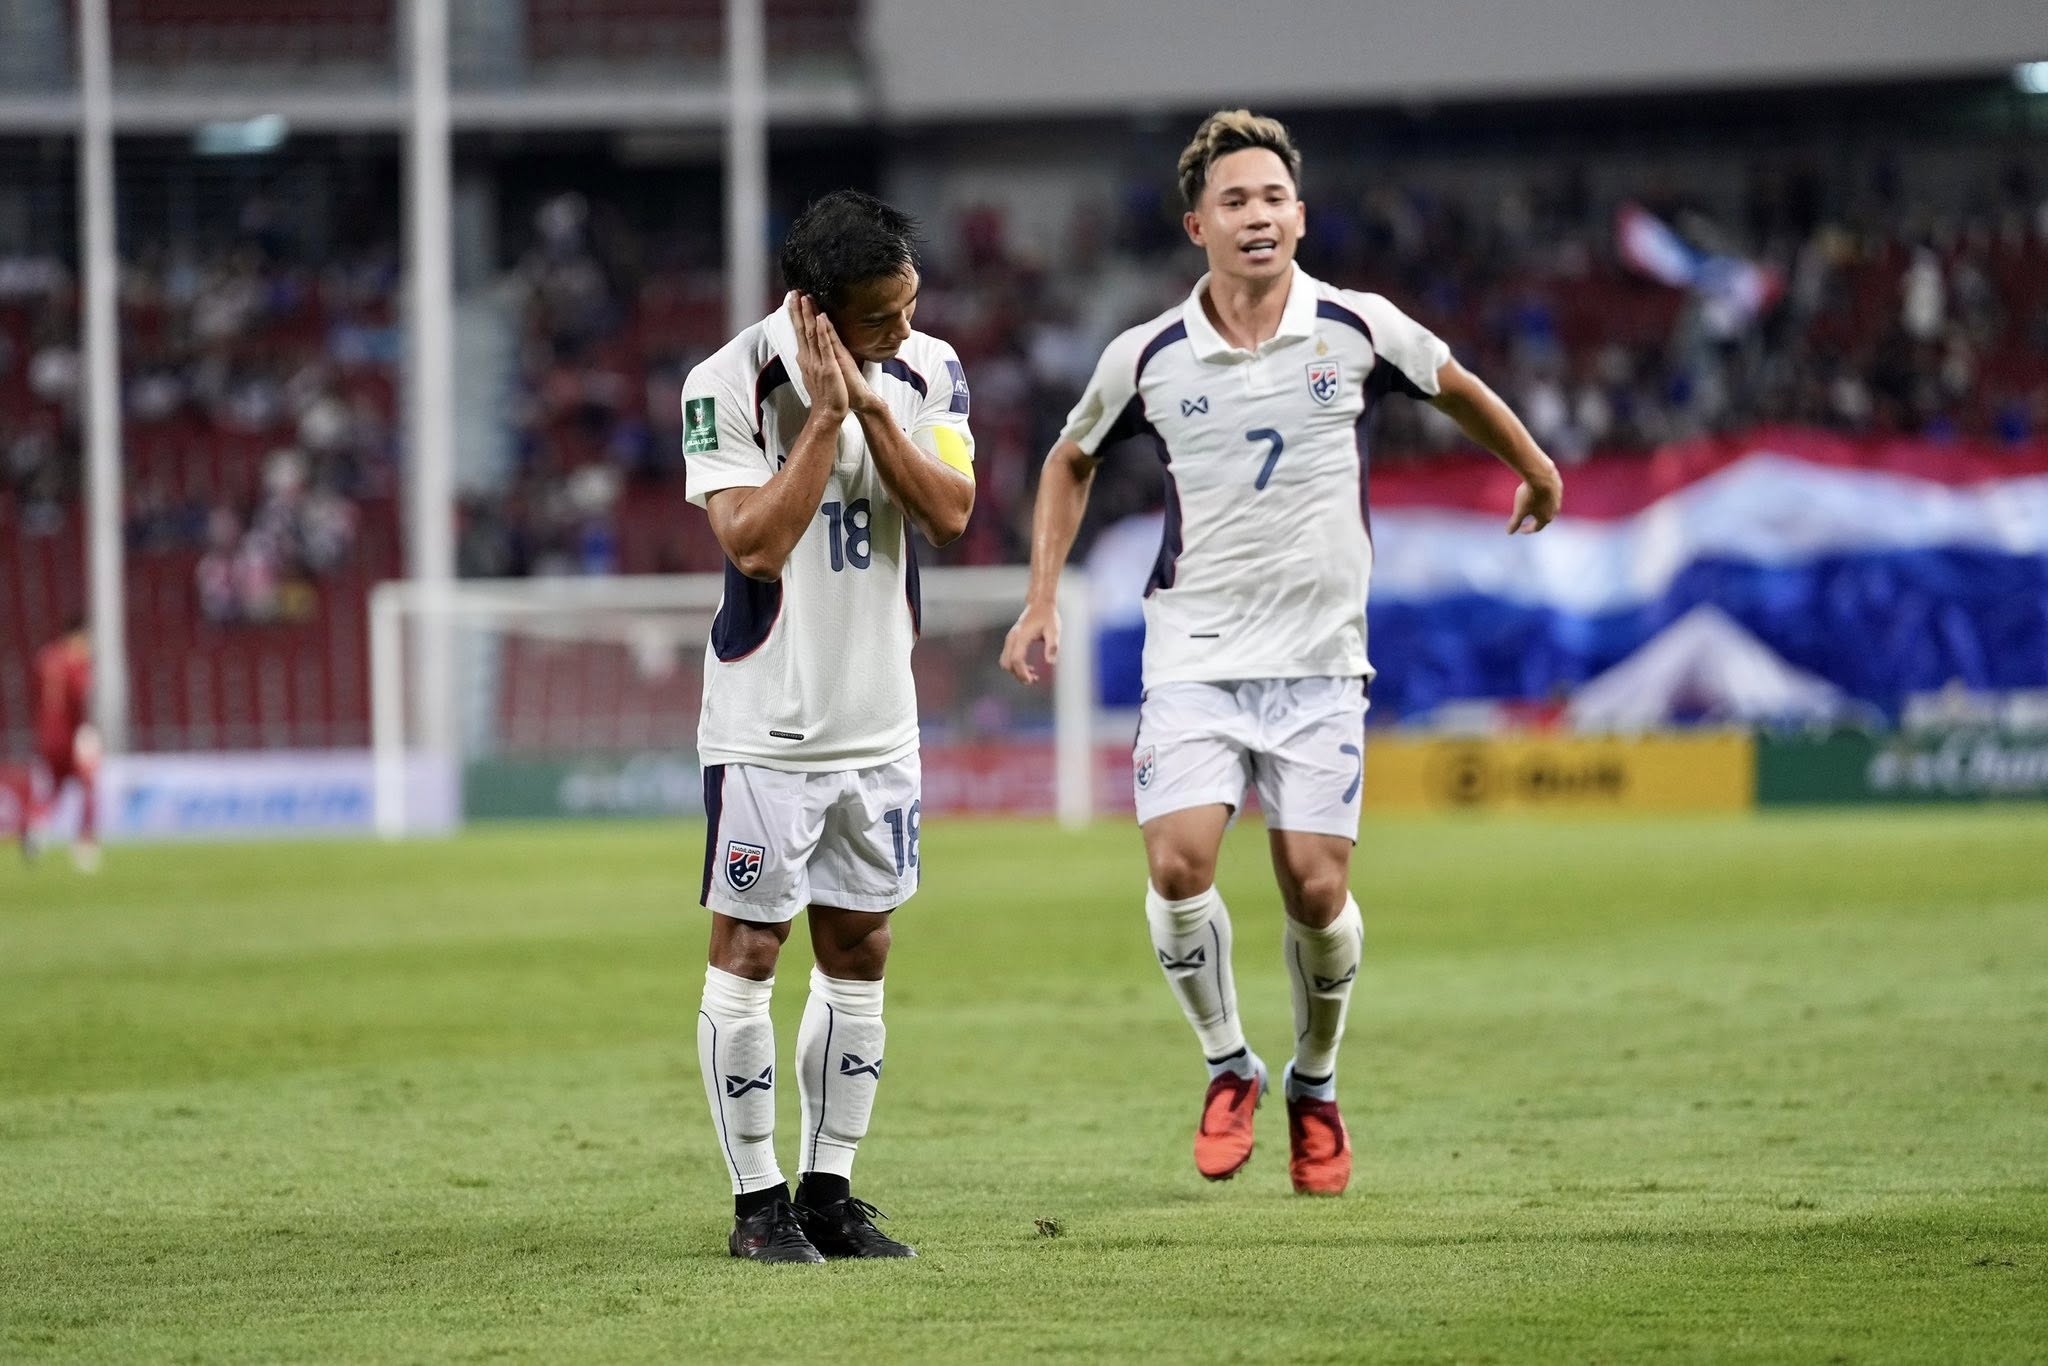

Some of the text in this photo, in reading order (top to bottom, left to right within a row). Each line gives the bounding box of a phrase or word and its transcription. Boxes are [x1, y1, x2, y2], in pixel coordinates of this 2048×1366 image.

[686, 437, 717, 446] QUALIFIERS
[1246, 428, 1284, 490] 7
[821, 498, 871, 572] 18
[1339, 744, 1361, 804] 7
[731, 845, 761, 855] THAILAND
[883, 799, 920, 877] 18
